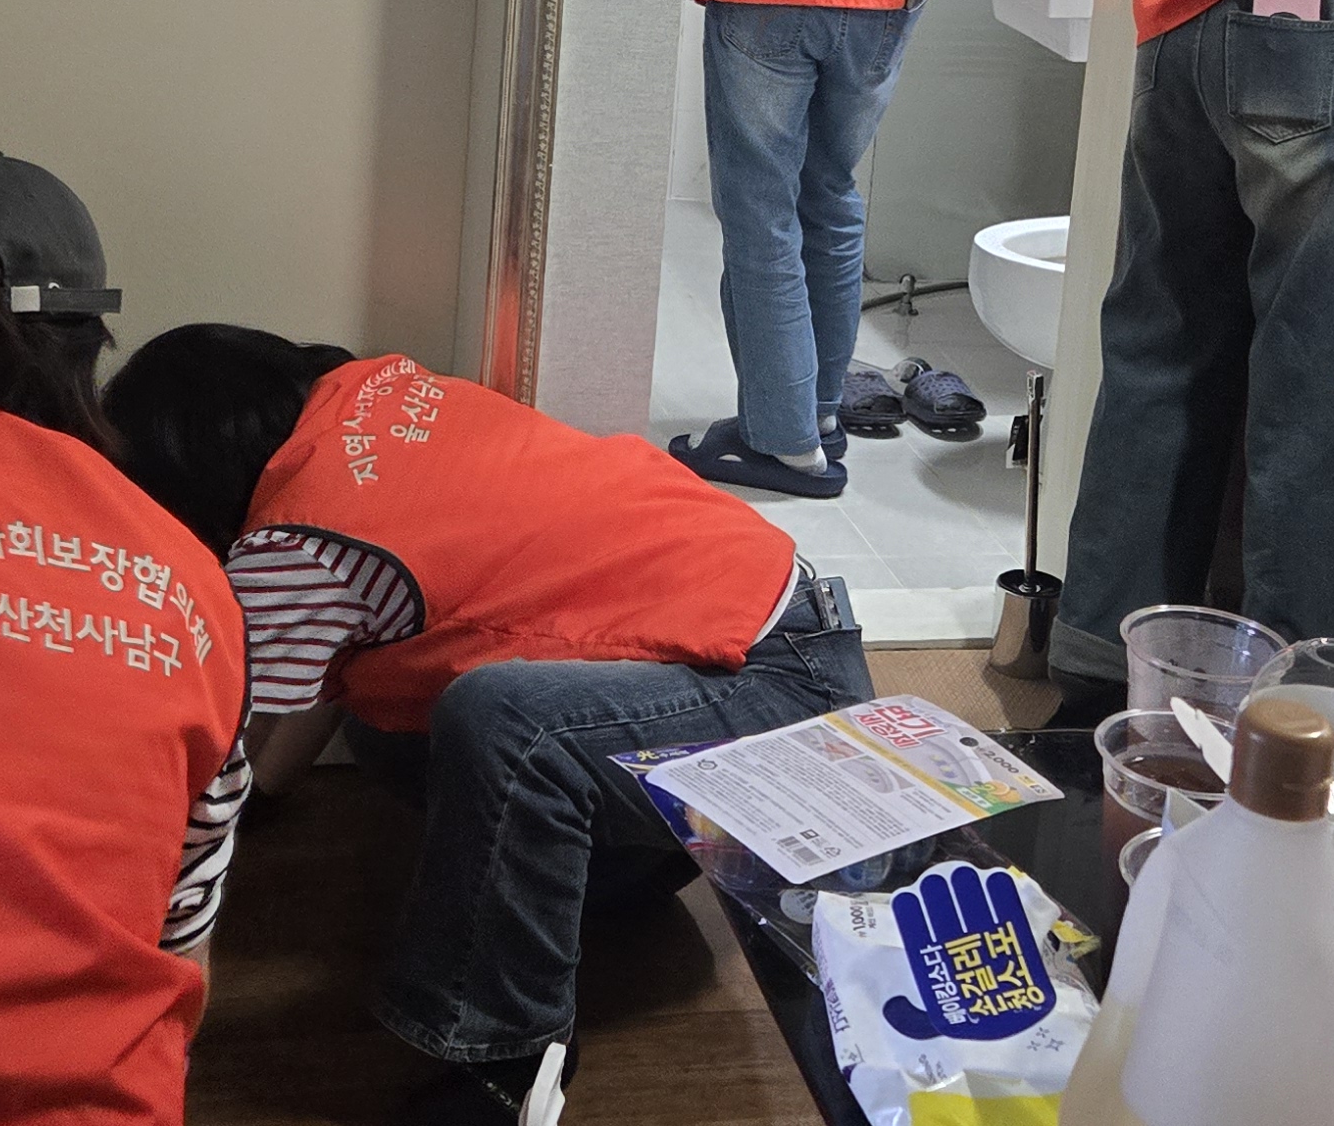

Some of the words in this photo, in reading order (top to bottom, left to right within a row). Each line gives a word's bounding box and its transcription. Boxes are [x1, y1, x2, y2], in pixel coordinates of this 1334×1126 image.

[390, 376, 445, 444] 울산남
[855, 713, 920, 749] 세정제
[873, 705, 944, 739] 변기
[920, 944, 967, 1025] 베이킹소다
[944, 933, 999, 1016] 손걸레
[984, 921, 1045, 1010] 청소포
